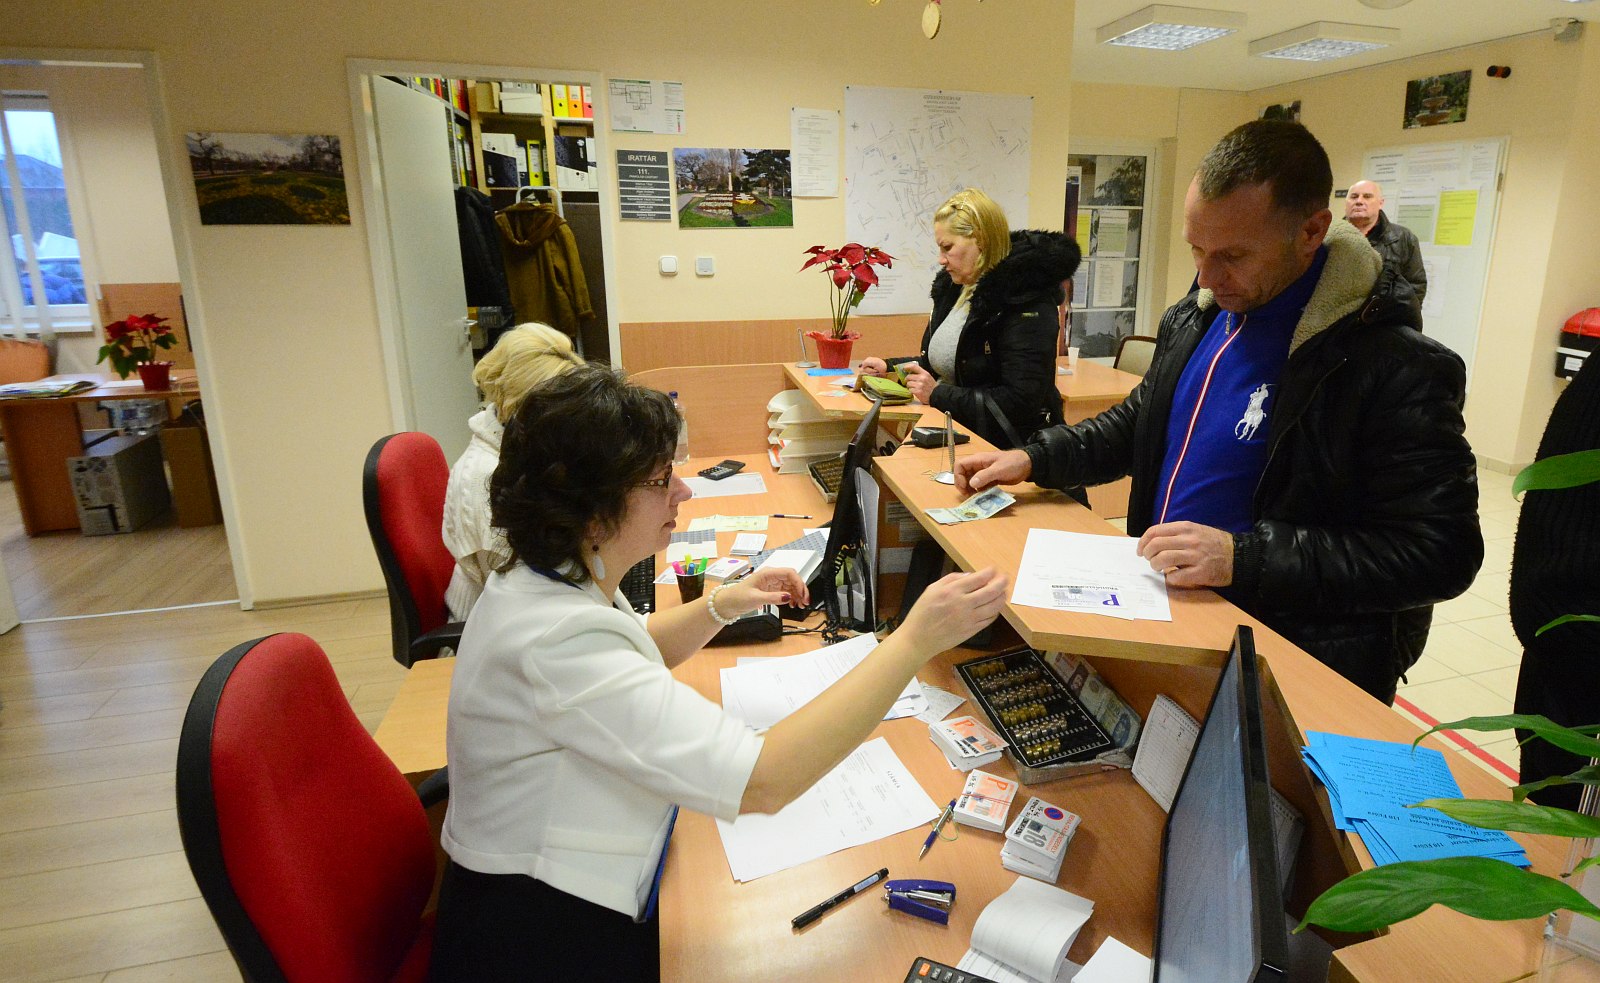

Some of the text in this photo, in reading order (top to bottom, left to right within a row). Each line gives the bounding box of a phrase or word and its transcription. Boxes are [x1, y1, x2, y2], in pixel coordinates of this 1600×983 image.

[627, 154, 657, 162] IRATTÁR
[1102, 594, 1120, 606] P
[953, 719, 974, 727] P
[987, 777, 1008, 790] P
